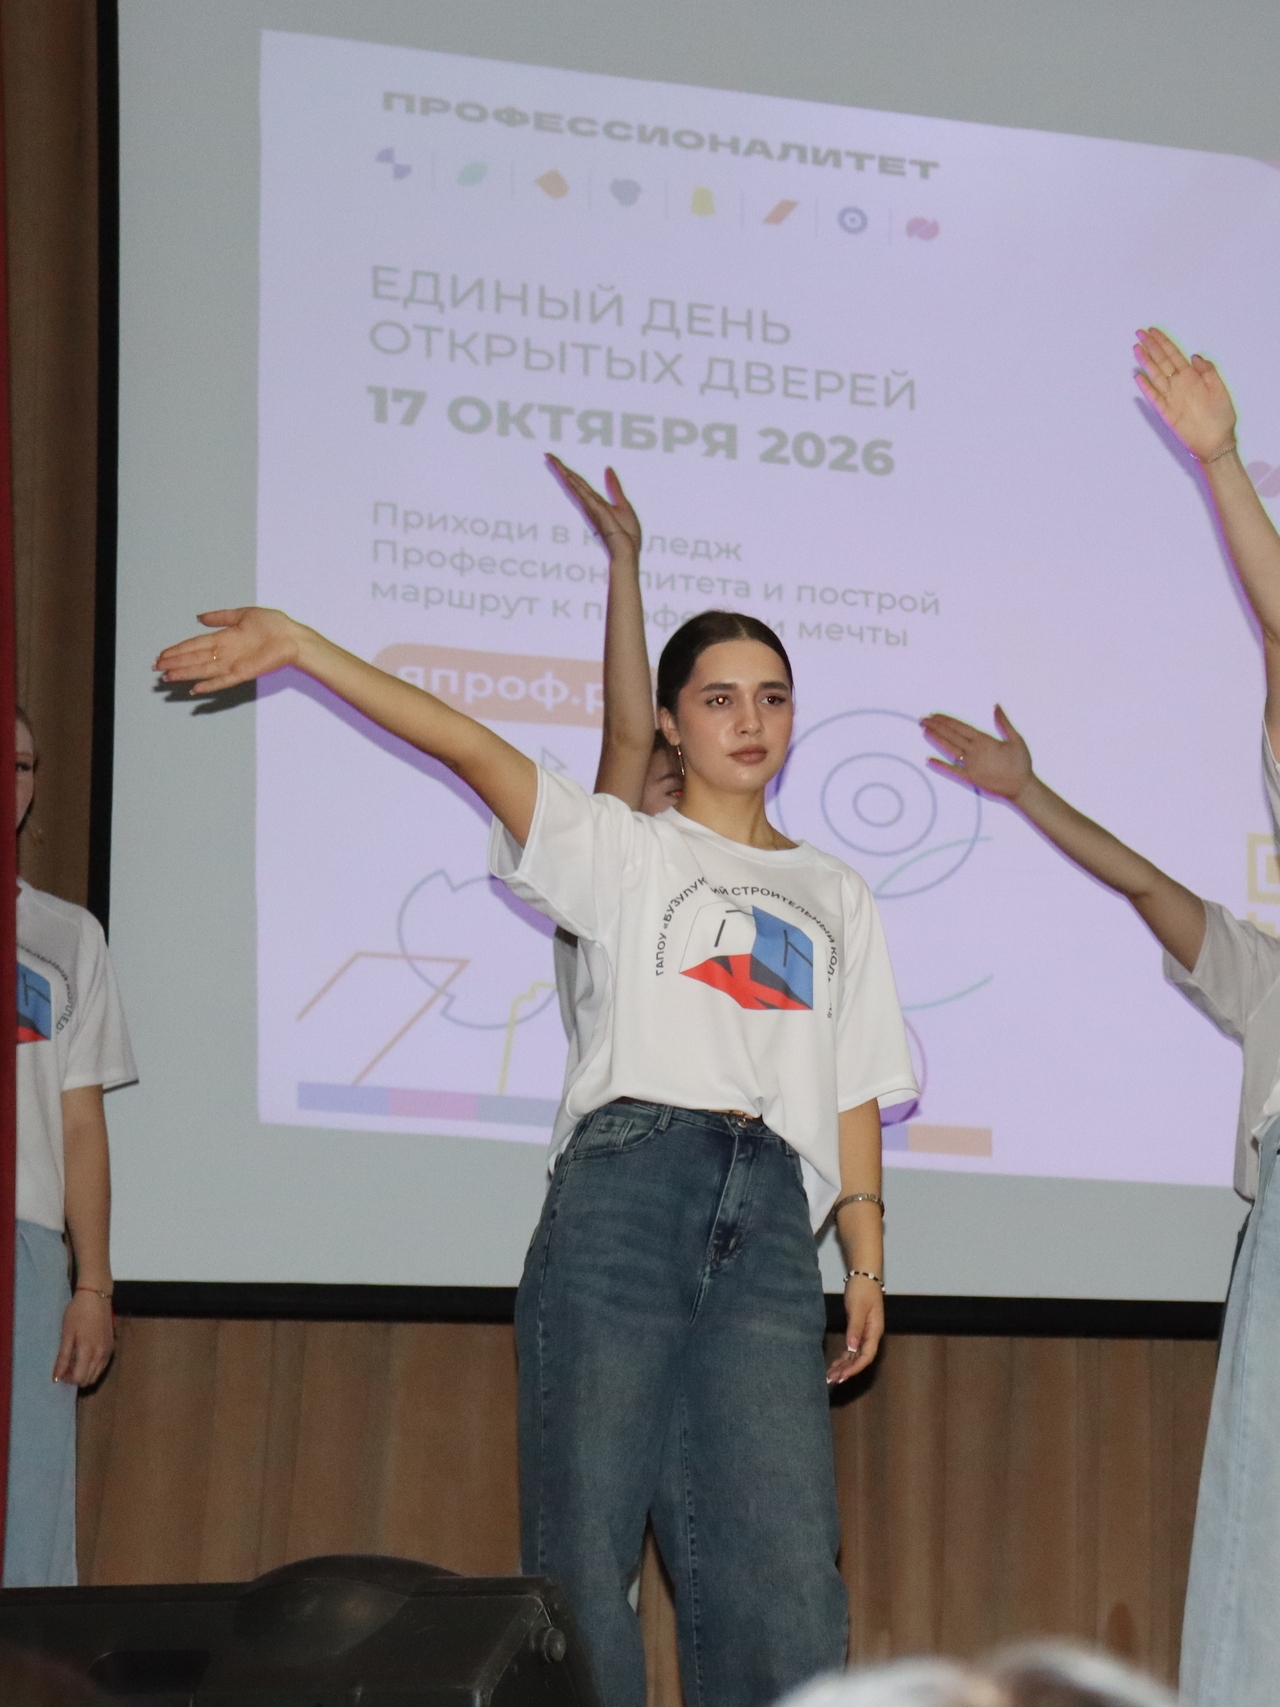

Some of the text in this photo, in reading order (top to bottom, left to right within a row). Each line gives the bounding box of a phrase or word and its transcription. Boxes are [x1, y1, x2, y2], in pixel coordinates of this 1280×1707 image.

[381, 91, 941, 180] ПРОФЕССИОНАЛИТЕТ
[371, 265, 792, 345] ЕДИНЫЙ ДЕНЬ
[369, 320, 916, 411] ОТКРЫТЫХ ДВЕРЕЙ
[367, 385, 896, 476] 17 ОКТЯБРЯ 2026
[373, 501, 742, 561] Приходи в кледж
[371, 581, 541, 620] маршрут
[552, 598, 570, 619] к
[799, 619, 908, 647] мечты
[372, 539, 940, 616] Профессионлитета и построй
[397, 665, 604, 714] япроф.р
[655, 932, 667, 977] ГАПОУ
